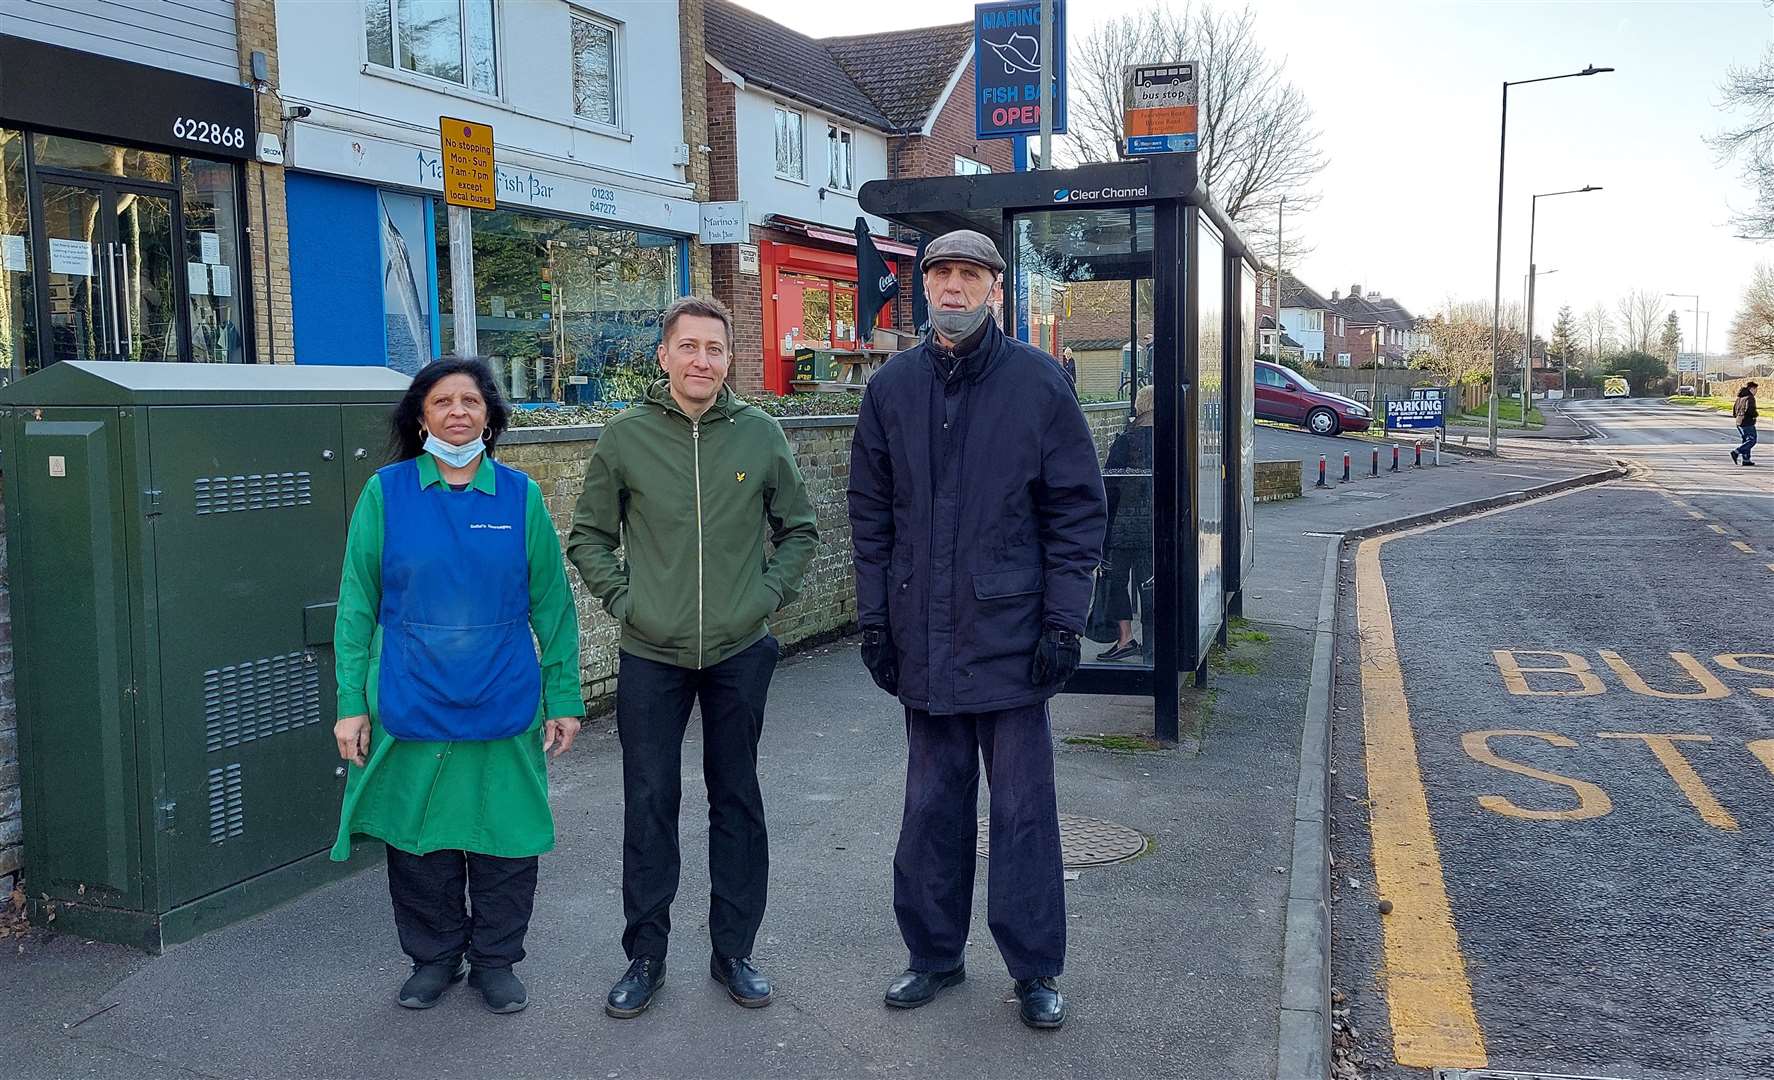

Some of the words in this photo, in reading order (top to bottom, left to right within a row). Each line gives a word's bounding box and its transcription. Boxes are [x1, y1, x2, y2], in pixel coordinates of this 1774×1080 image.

[983, 86, 1019, 104] FISH
[1142, 91, 1159, 100] bus
[1162, 90, 1185, 100] stop
[173, 117, 245, 149] 622868
[445, 137, 457, 148] No
[459, 141, 491, 156] stopping
[450, 152, 467, 164] Mon
[472, 156, 487, 168] Sun
[458, 181, 483, 193] except
[496, 165, 524, 198] Fish
[528, 171, 554, 203] Bar
[450, 190, 468, 201] local
[470, 192, 491, 205] buses
[591, 187, 615, 201] 01233
[1070, 189, 1100, 201] Clear
[1101, 184, 1148, 198] Channel
[589, 202, 616, 216] 647272
[703, 216, 739, 230] Marino's
[1388, 401, 1442, 412] PARKING
[1459, 729, 1774, 832] ST
